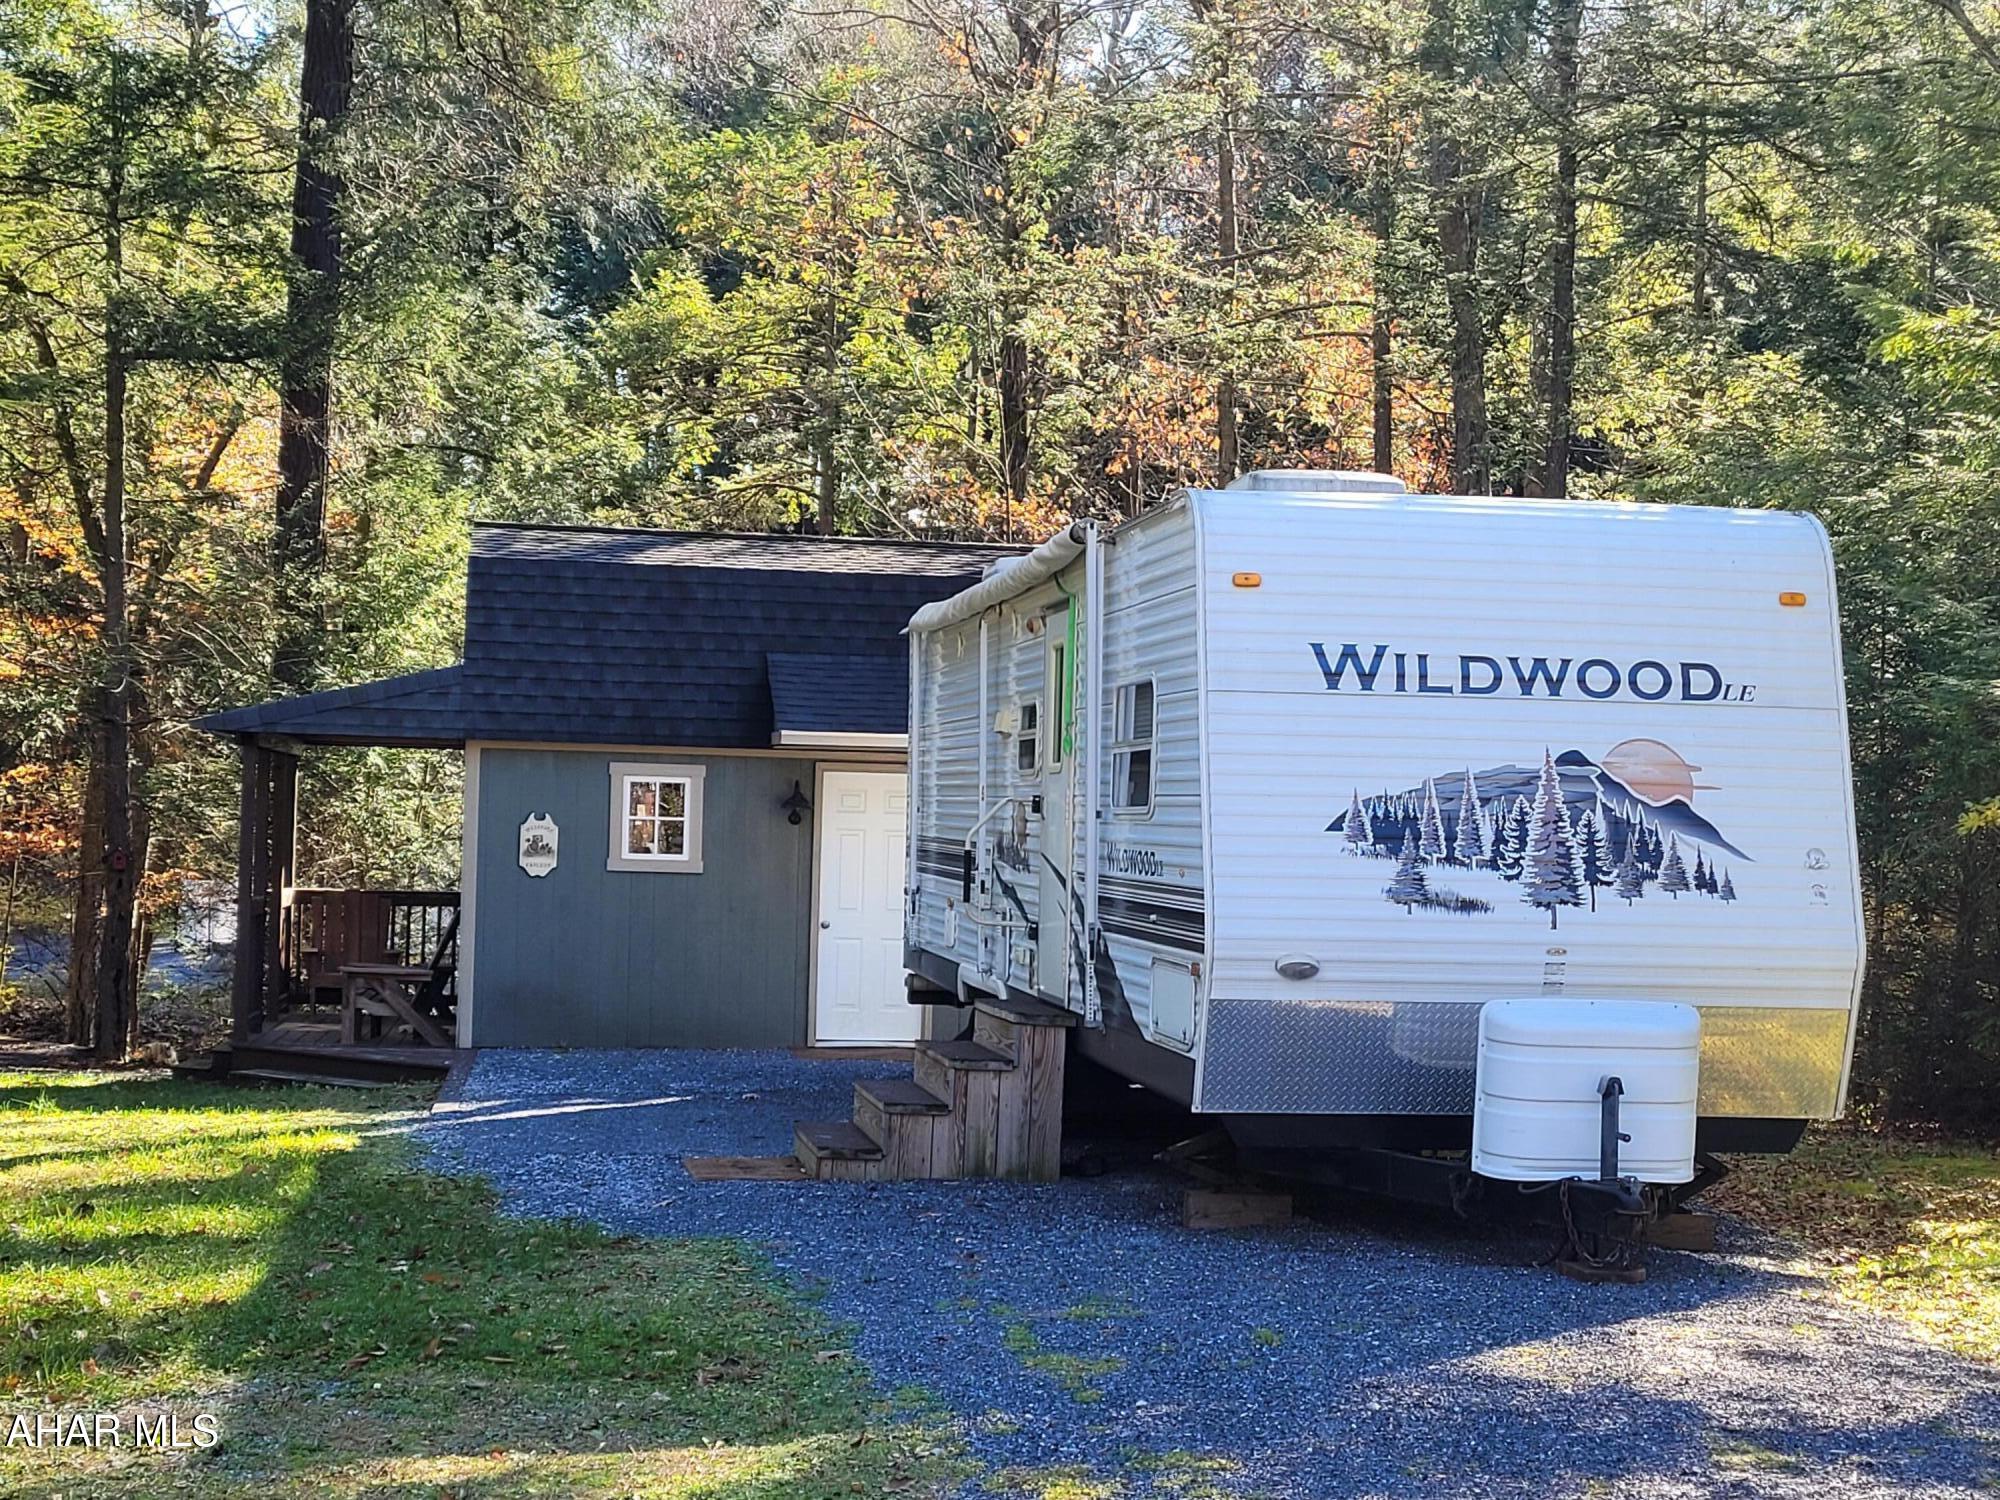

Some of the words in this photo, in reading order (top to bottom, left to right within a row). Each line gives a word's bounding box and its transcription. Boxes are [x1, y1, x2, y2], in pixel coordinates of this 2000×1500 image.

[1308, 643, 1723, 701] WILDWOOD
[1722, 684, 1757, 702] LE
[1106, 841, 1156, 876] WILDWOOD
